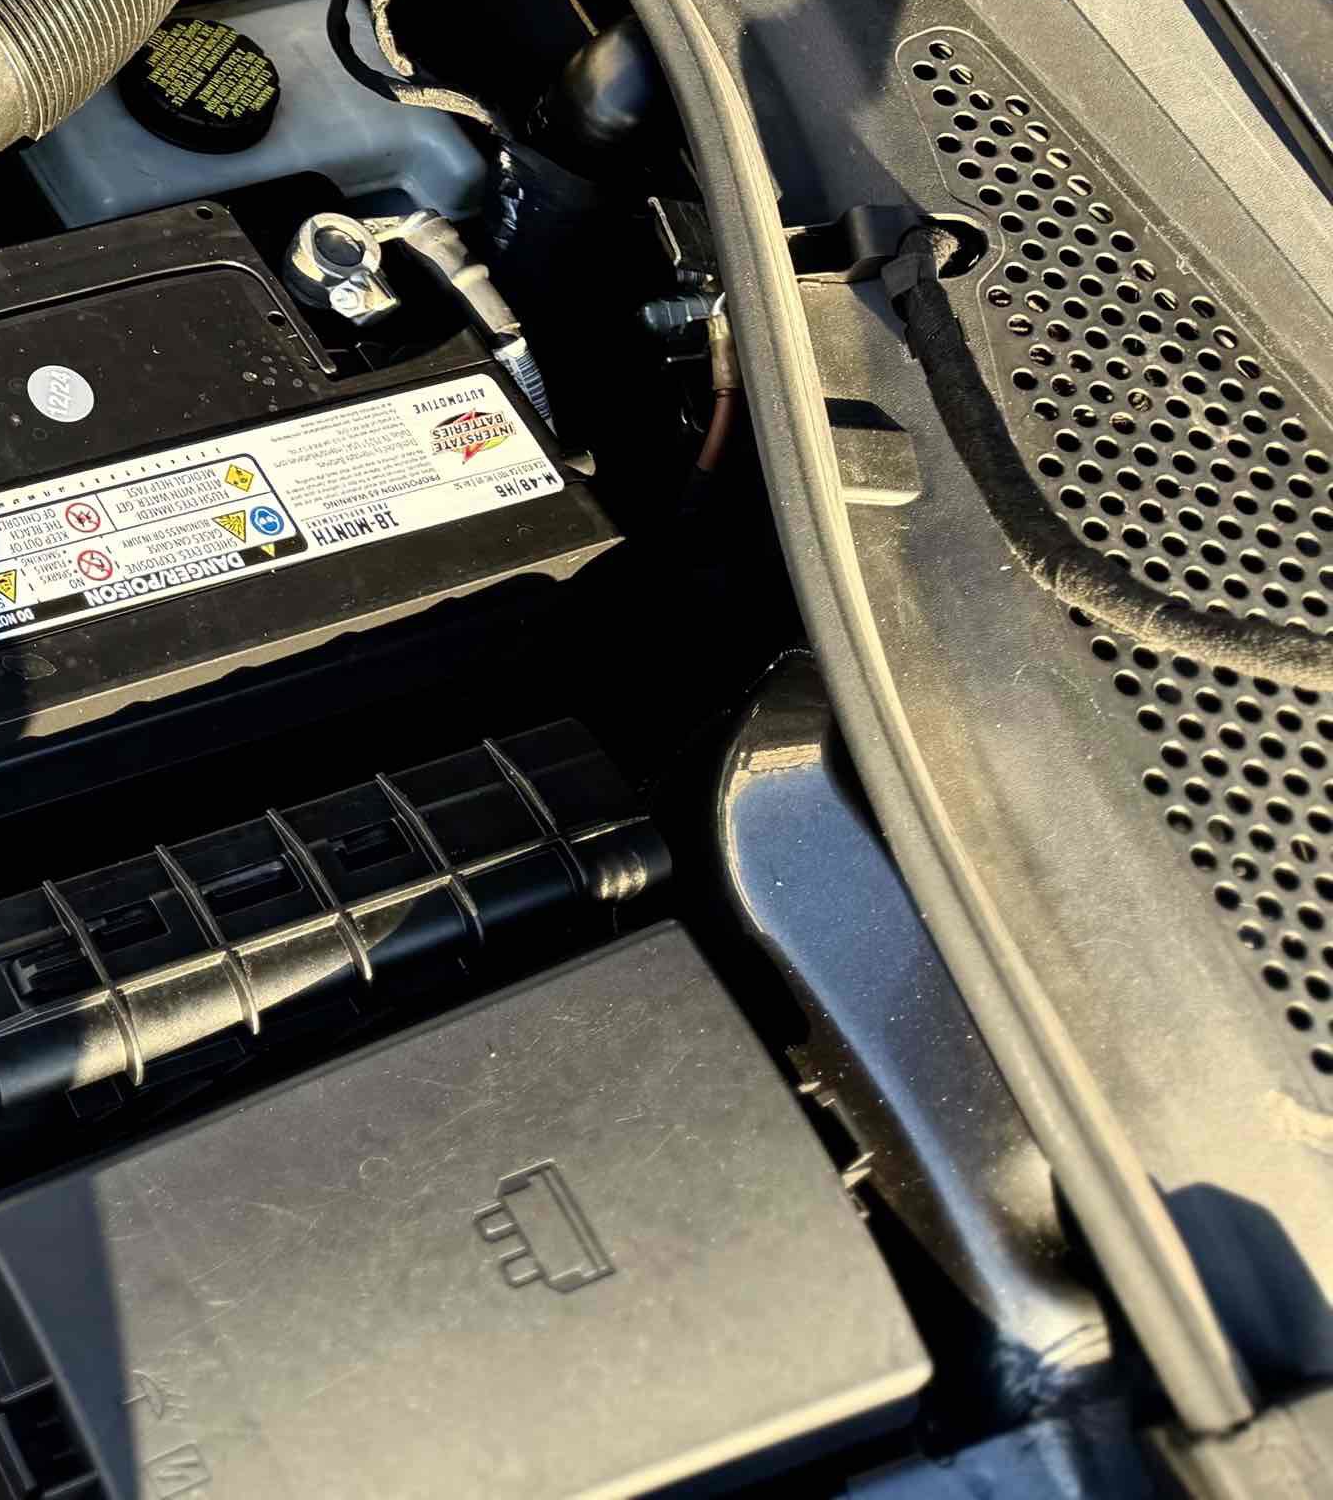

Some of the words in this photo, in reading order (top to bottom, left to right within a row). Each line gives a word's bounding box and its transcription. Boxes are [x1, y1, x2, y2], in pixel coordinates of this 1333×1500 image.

[47, 370, 73, 417] 12/24
[412, 387, 486, 414] AUTOMOTIVE
[430, 412, 504, 440] BATTERIES
[431, 423, 514, 453] INTERSTATE
[173, 466, 216, 486] MEDICAL
[380, 472, 441, 495] PROPOSITION
[492, 467, 556, 499] M-48/H6
[146, 477, 174, 493] HELP
[166, 483, 197, 500] WITH
[195, 477, 222, 493] ATELY
[173, 496, 198, 511] EYES
[197, 488, 229, 505] FLUSH
[322, 491, 368, 510] WARNING
[41, 507, 56, 520] OF
[114, 499, 134, 514] GET
[9, 523, 42, 540] REACH
[41, 517, 62, 532] THE
[164, 517, 210, 538] BLINDNESS
[312, 509, 398, 547] 18-MONTH
[43, 529, 69, 545] KEEP
[191, 526, 222, 543] GASES
[8, 541, 23, 554] OF
[22, 536, 43, 551] OUT
[146, 539, 174, 556] CAUSE
[202, 535, 236, 554] SHIELD
[124, 551, 176, 575] EXPLOSIVE
[68, 576, 85, 589] NO
[84, 549, 244, 608] DANGER/POISON
[15, 606, 34, 622] DO
